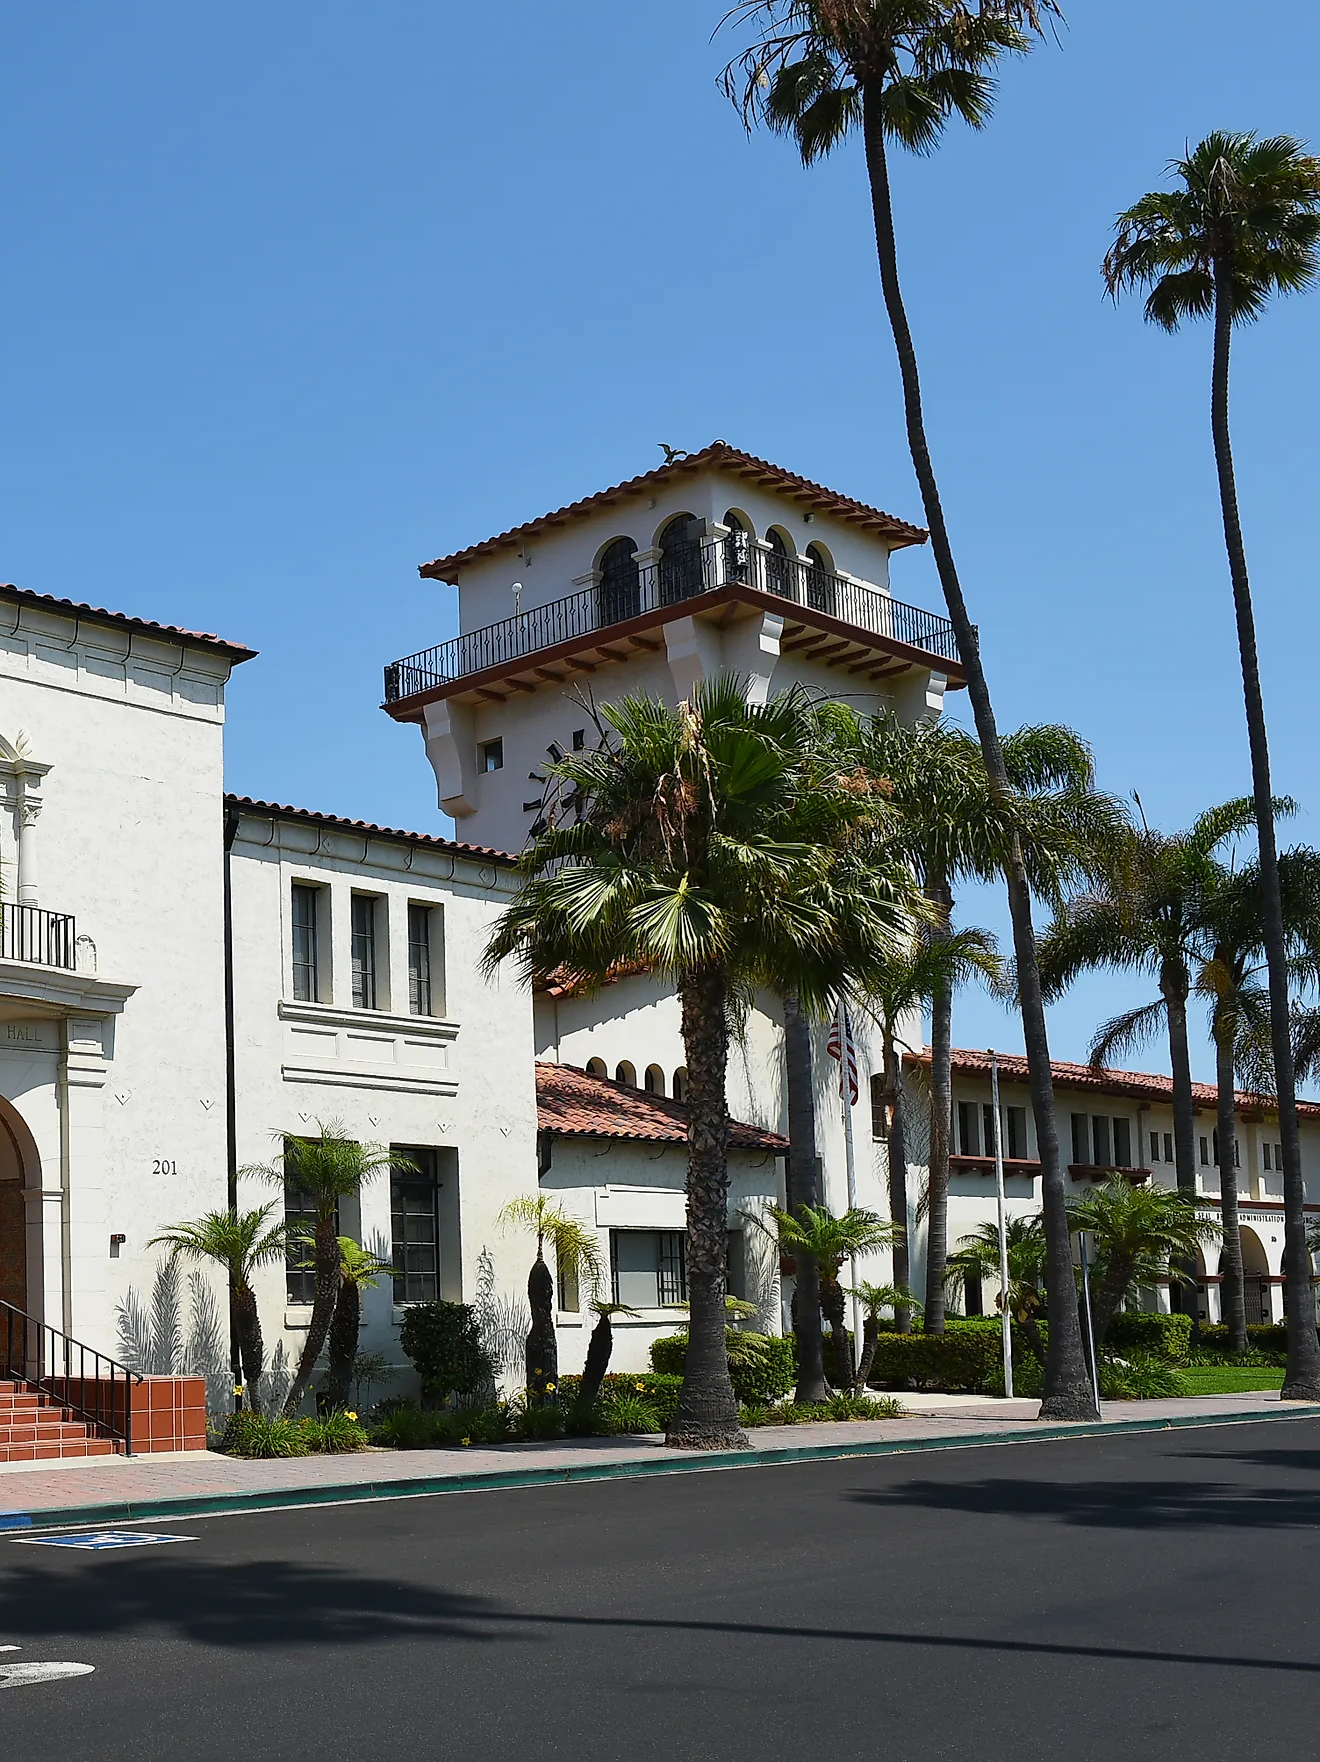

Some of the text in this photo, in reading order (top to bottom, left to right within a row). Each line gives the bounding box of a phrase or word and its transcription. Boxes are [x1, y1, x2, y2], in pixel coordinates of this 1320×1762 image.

[7, 1025, 43, 1042] HALL
[152, 1159, 178, 1176] 201
[1239, 1214, 1284, 1223] ADMINISTRATION
